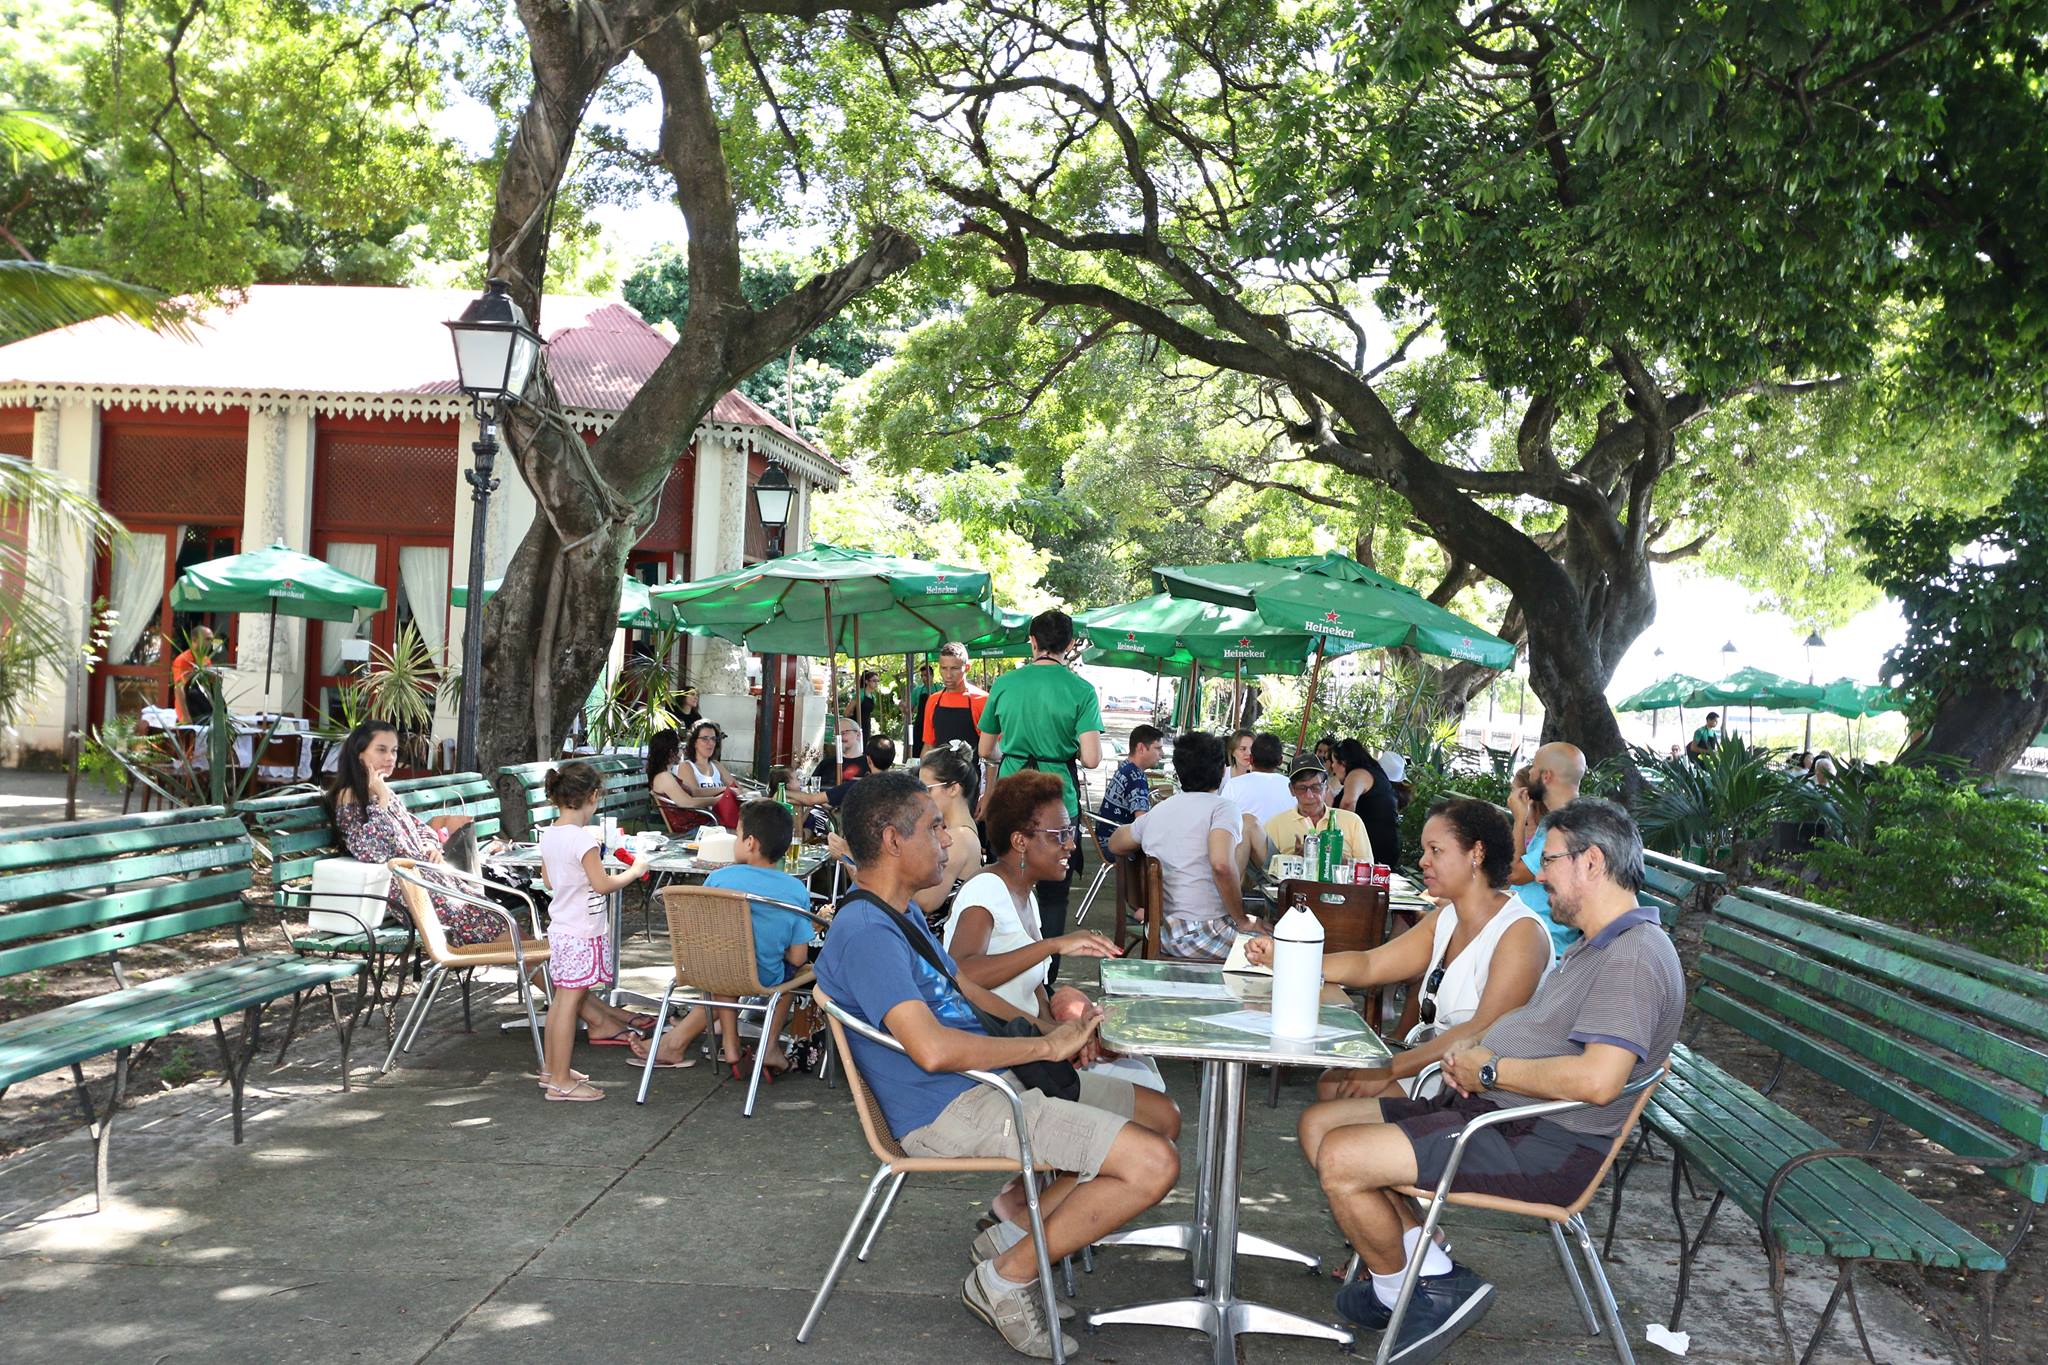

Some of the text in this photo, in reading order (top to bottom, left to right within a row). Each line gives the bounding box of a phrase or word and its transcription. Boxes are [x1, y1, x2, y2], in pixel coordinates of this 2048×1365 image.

[268, 588, 306, 600] Heineken
[926, 586, 958, 594] Heineken
[1304, 620, 1356, 638] Heineken
[1117, 641, 1146, 653] Heineken
[1224, 648, 1266, 658] Heineken
[1450, 647, 1484, 663] Heineken
